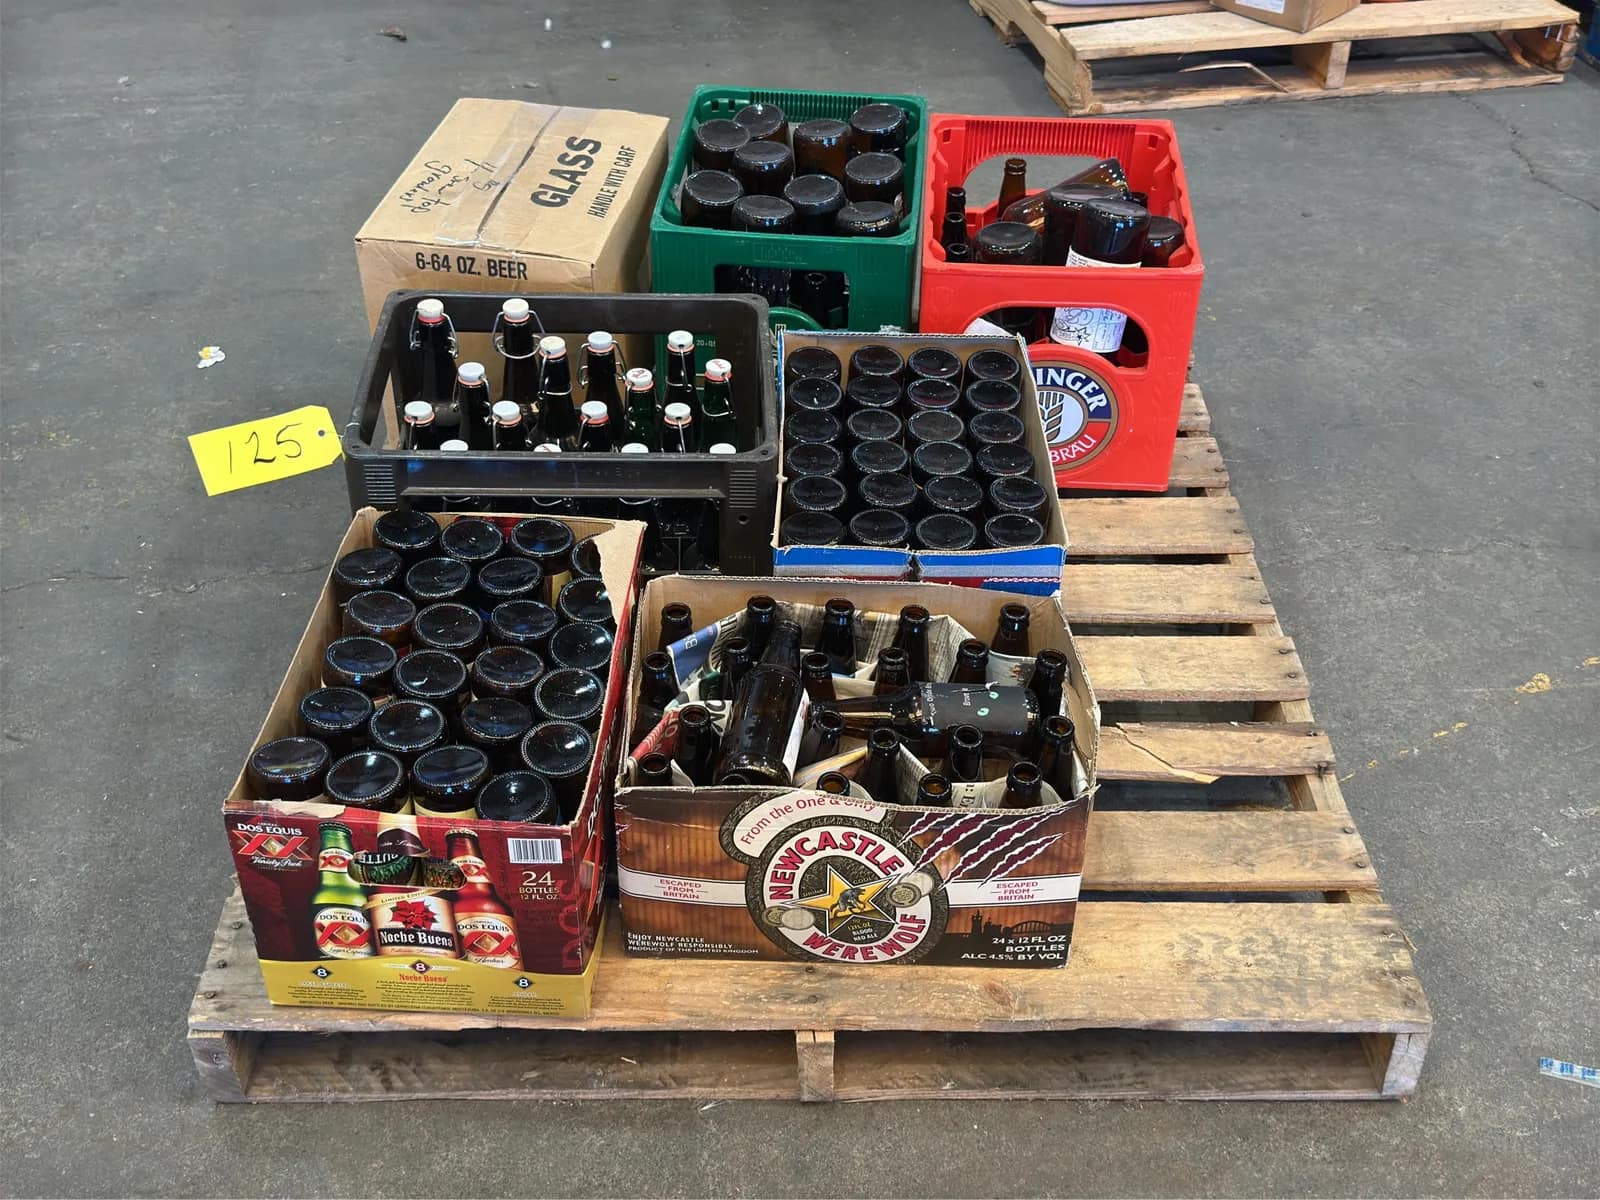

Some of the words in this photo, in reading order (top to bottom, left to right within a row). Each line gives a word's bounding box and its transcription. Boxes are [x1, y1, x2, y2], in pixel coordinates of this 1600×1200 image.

[530, 136, 602, 207] GLASS
[586, 187, 618, 218] HANDLE
[602, 168, 628, 188] WITH
[415, 252, 452, 272] 6-64
[456, 255, 481, 276] OZ.
[487, 258, 528, 280] BEER
[228, 422, 303, 474] 125
[1049, 434, 1097, 463] BRÄU
[740, 815, 771, 845] From
[769, 803, 795, 820] the
[795, 796, 826, 811] One
[236, 823, 263, 833] DOS
[265, 826, 303, 836] EQUIS
[769, 830, 905, 900] NEWCASTLE
[521, 870, 556, 886] 24
[659, 879, 702, 889] ESCAPED
[667, 885, 695, 893] FROM
[996, 881, 1039, 889] ESCAPED
[518, 886, 560, 894] BOTTLES
[662, 891, 700, 900] BRITAIN
[456, 923, 479, 931] DOS
[379, 929, 416, 945] Noche
[417, 931, 453, 947] Buena
[627, 932, 652, 941] ENJOY
[655, 935, 706, 944] NEWCASTLE
[802, 913, 928, 961] WEREWOLF
[1018, 936, 1030, 944] 12
[627, 939, 676, 948] WEREWOLF
[627, 945, 664, 953] PRODUCT
[1005, 943, 1066, 953] BOTTLES
[415, 962, 426, 972] 8
[317, 968, 328, 978] 8
[519, 977, 530, 988] 8
